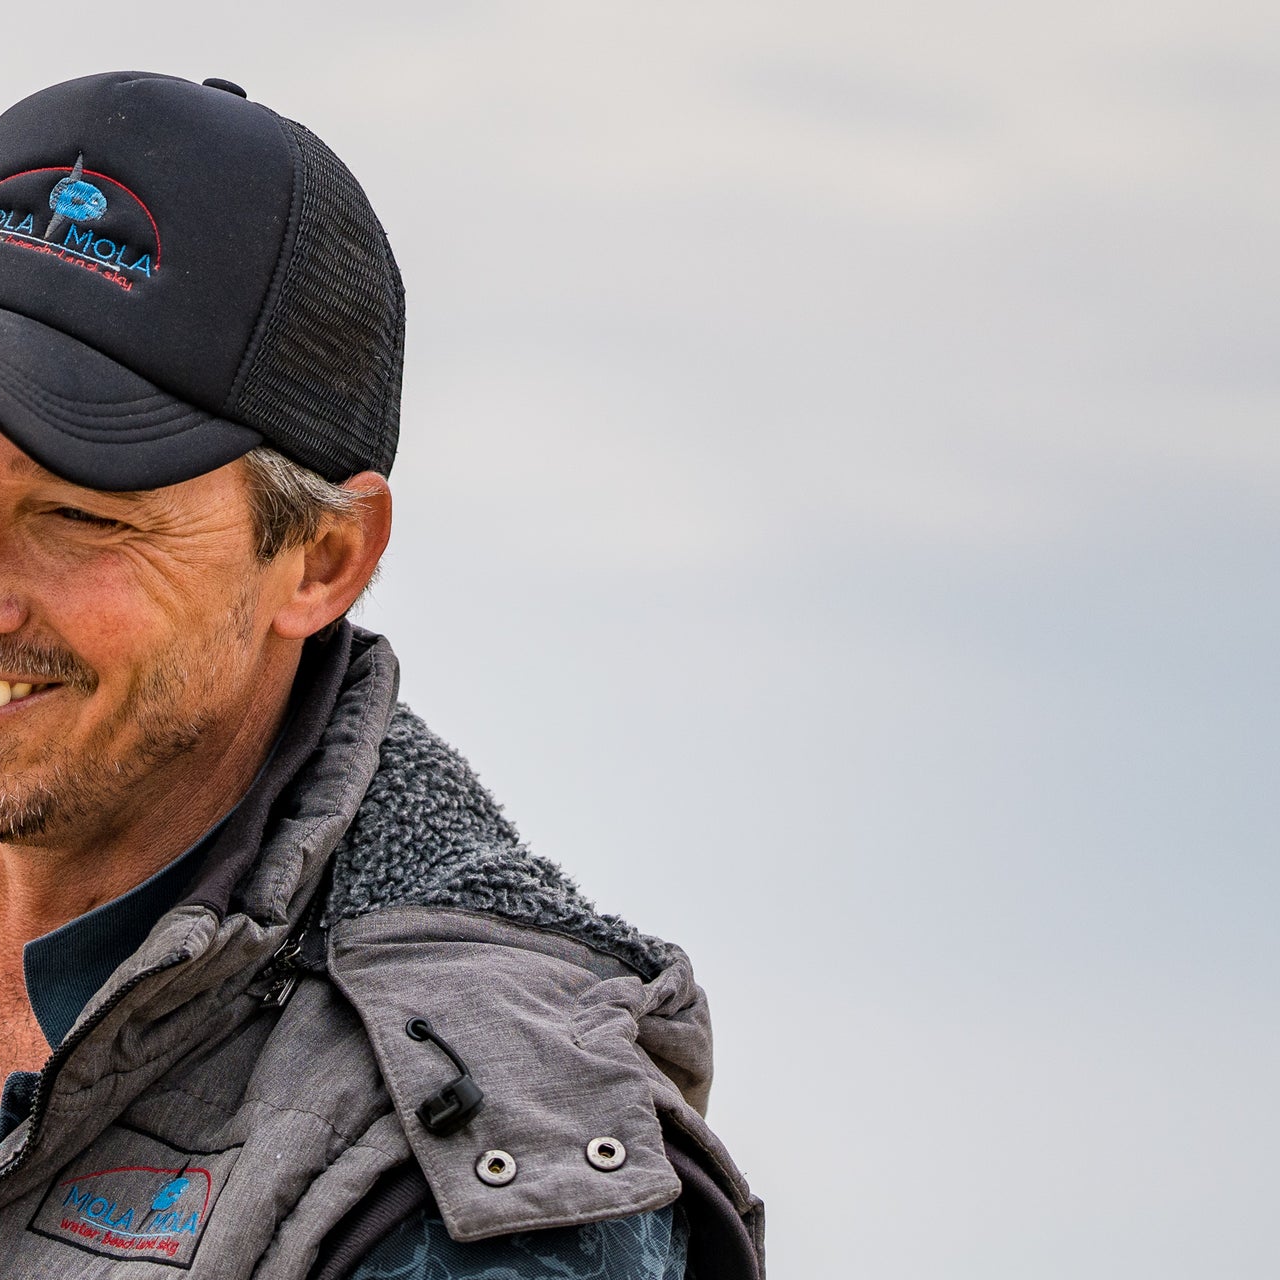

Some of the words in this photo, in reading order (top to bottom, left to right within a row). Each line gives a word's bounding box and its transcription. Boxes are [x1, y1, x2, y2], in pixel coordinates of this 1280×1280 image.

[57, 250, 98, 273] land
[102, 271, 133, 291] sky
[64, 223, 151, 278] MOLA
[60, 1218, 101, 1239] water
[63, 1186, 135, 1230] MOLA
[147, 1211, 199, 1235] MOLA
